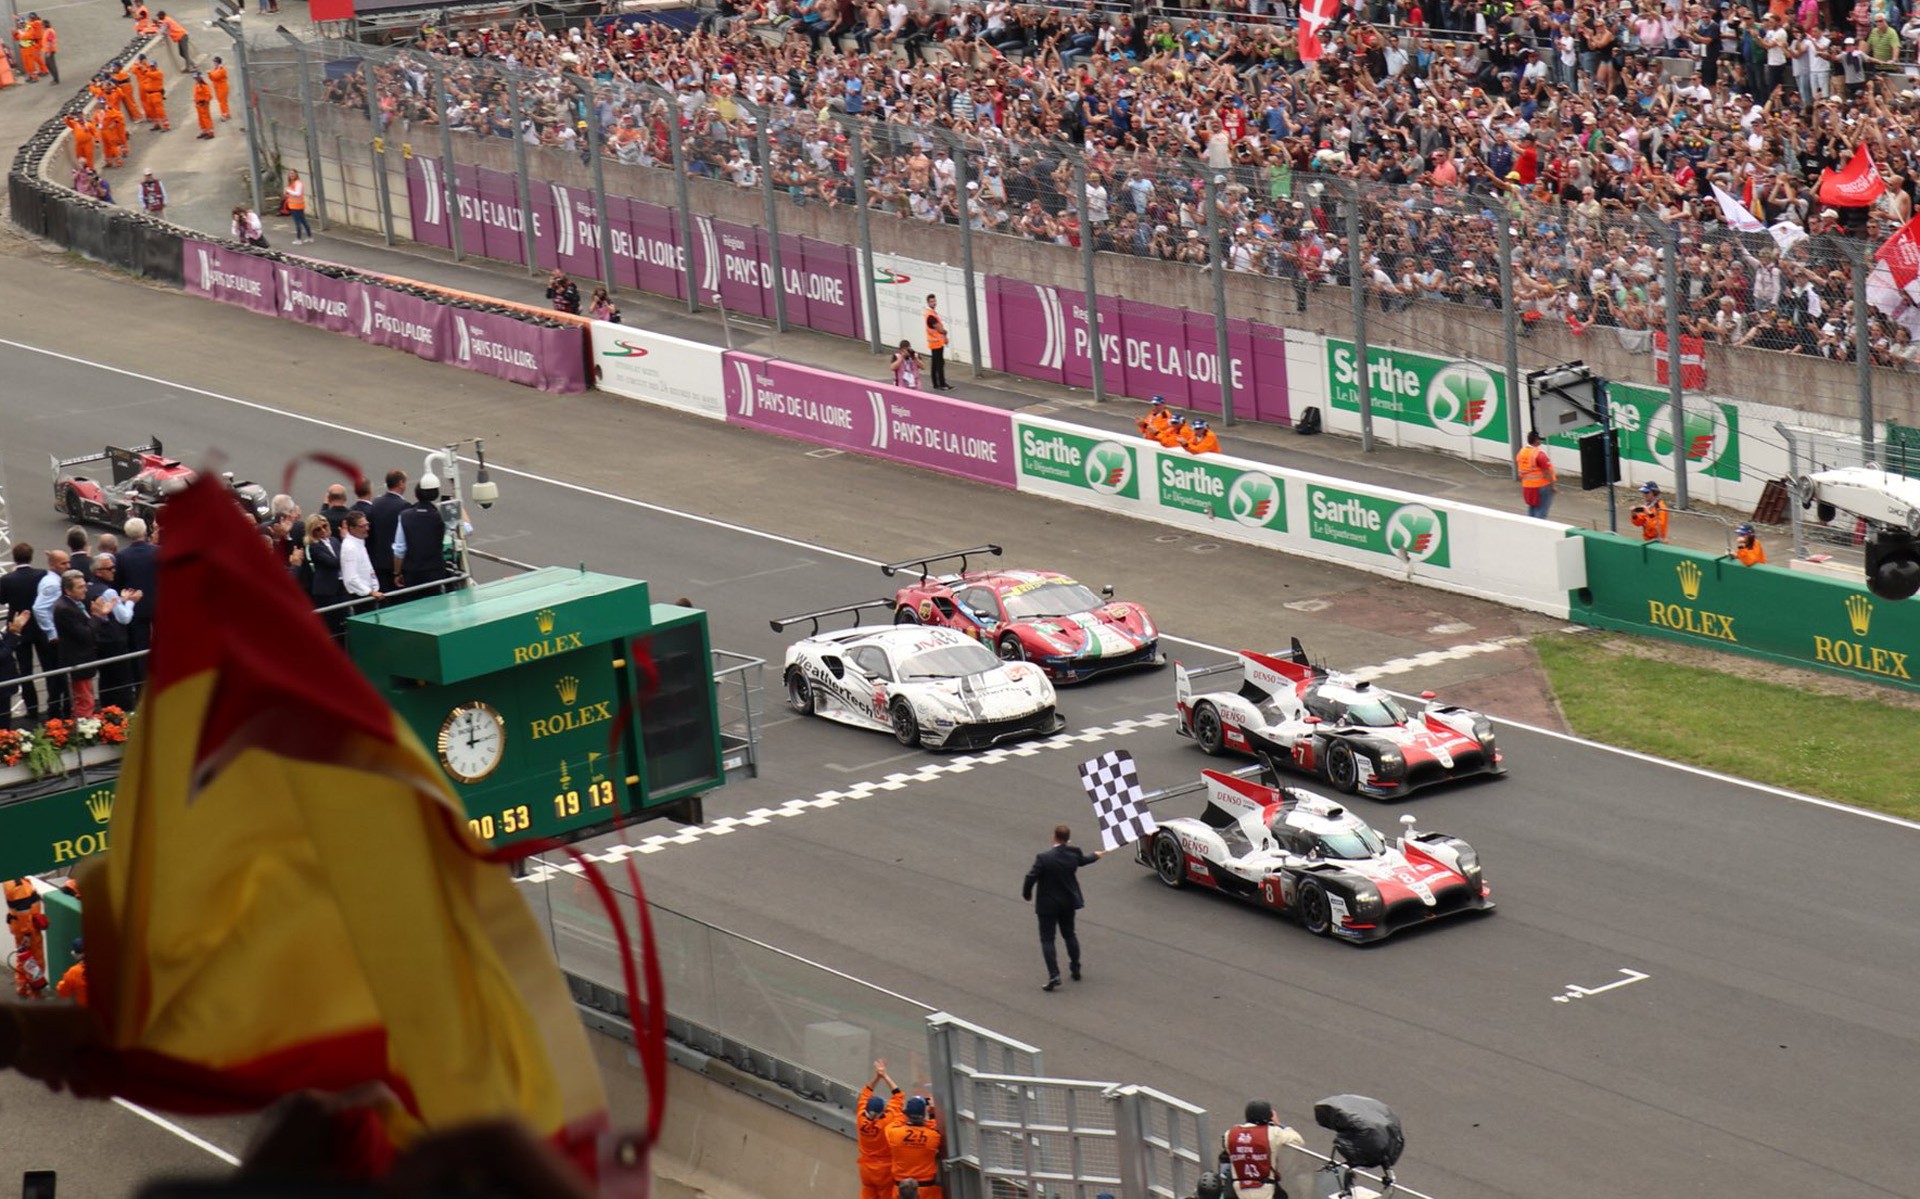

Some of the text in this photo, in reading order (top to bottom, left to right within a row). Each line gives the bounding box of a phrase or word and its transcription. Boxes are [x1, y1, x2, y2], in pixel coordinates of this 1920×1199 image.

[445, 191, 472, 219] PYS
[490, 202, 507, 229] LA
[578, 221, 686, 272] PAY DE LA LOIRE
[725, 254, 759, 286] PAYS
[760, 262, 774, 289] D
[782, 267, 803, 296] LA
[805, 270, 845, 306] LOIRE
[1072, 305, 1104, 324] Régn
[492, 343, 503, 360] DE
[1074, 328, 1244, 389] PYS DE LA LOIE
[758, 389, 853, 430] PAYS DE LA LOIRE
[1336, 386, 1405, 411] Le Dtement
[892, 421, 998, 463] PAYS DE LA LOIRE
[1023, 430, 1081, 467] Sarthe
[1024, 458, 1071, 478] Le Département
[1161, 459, 1225, 497] Sarthe
[1163, 490, 1173, 501] Le
[1312, 490, 1381, 531] Sarthe
[1314, 521, 1369, 543] Le Département
[1648, 600, 1738, 642] ROLEX
[513, 632, 584, 664] ROLEX
[1813, 635, 1912, 680] ROLEX
[795, 652, 874, 718] WeatherTech
[1253, 670, 1277, 684] DENSO
[530, 701, 613, 740] ROLEX
[1220, 709, 1246, 724] DENSO
[1297, 747, 1305, 765] 7
[554, 790, 581, 818] 19
[588, 780, 614, 807] 13
[1217, 791, 1242, 806] DENSO
[52, 831, 111, 863] ROL
[1181, 837, 1209, 855] DENSO
[1265, 883, 1275, 904] 8
